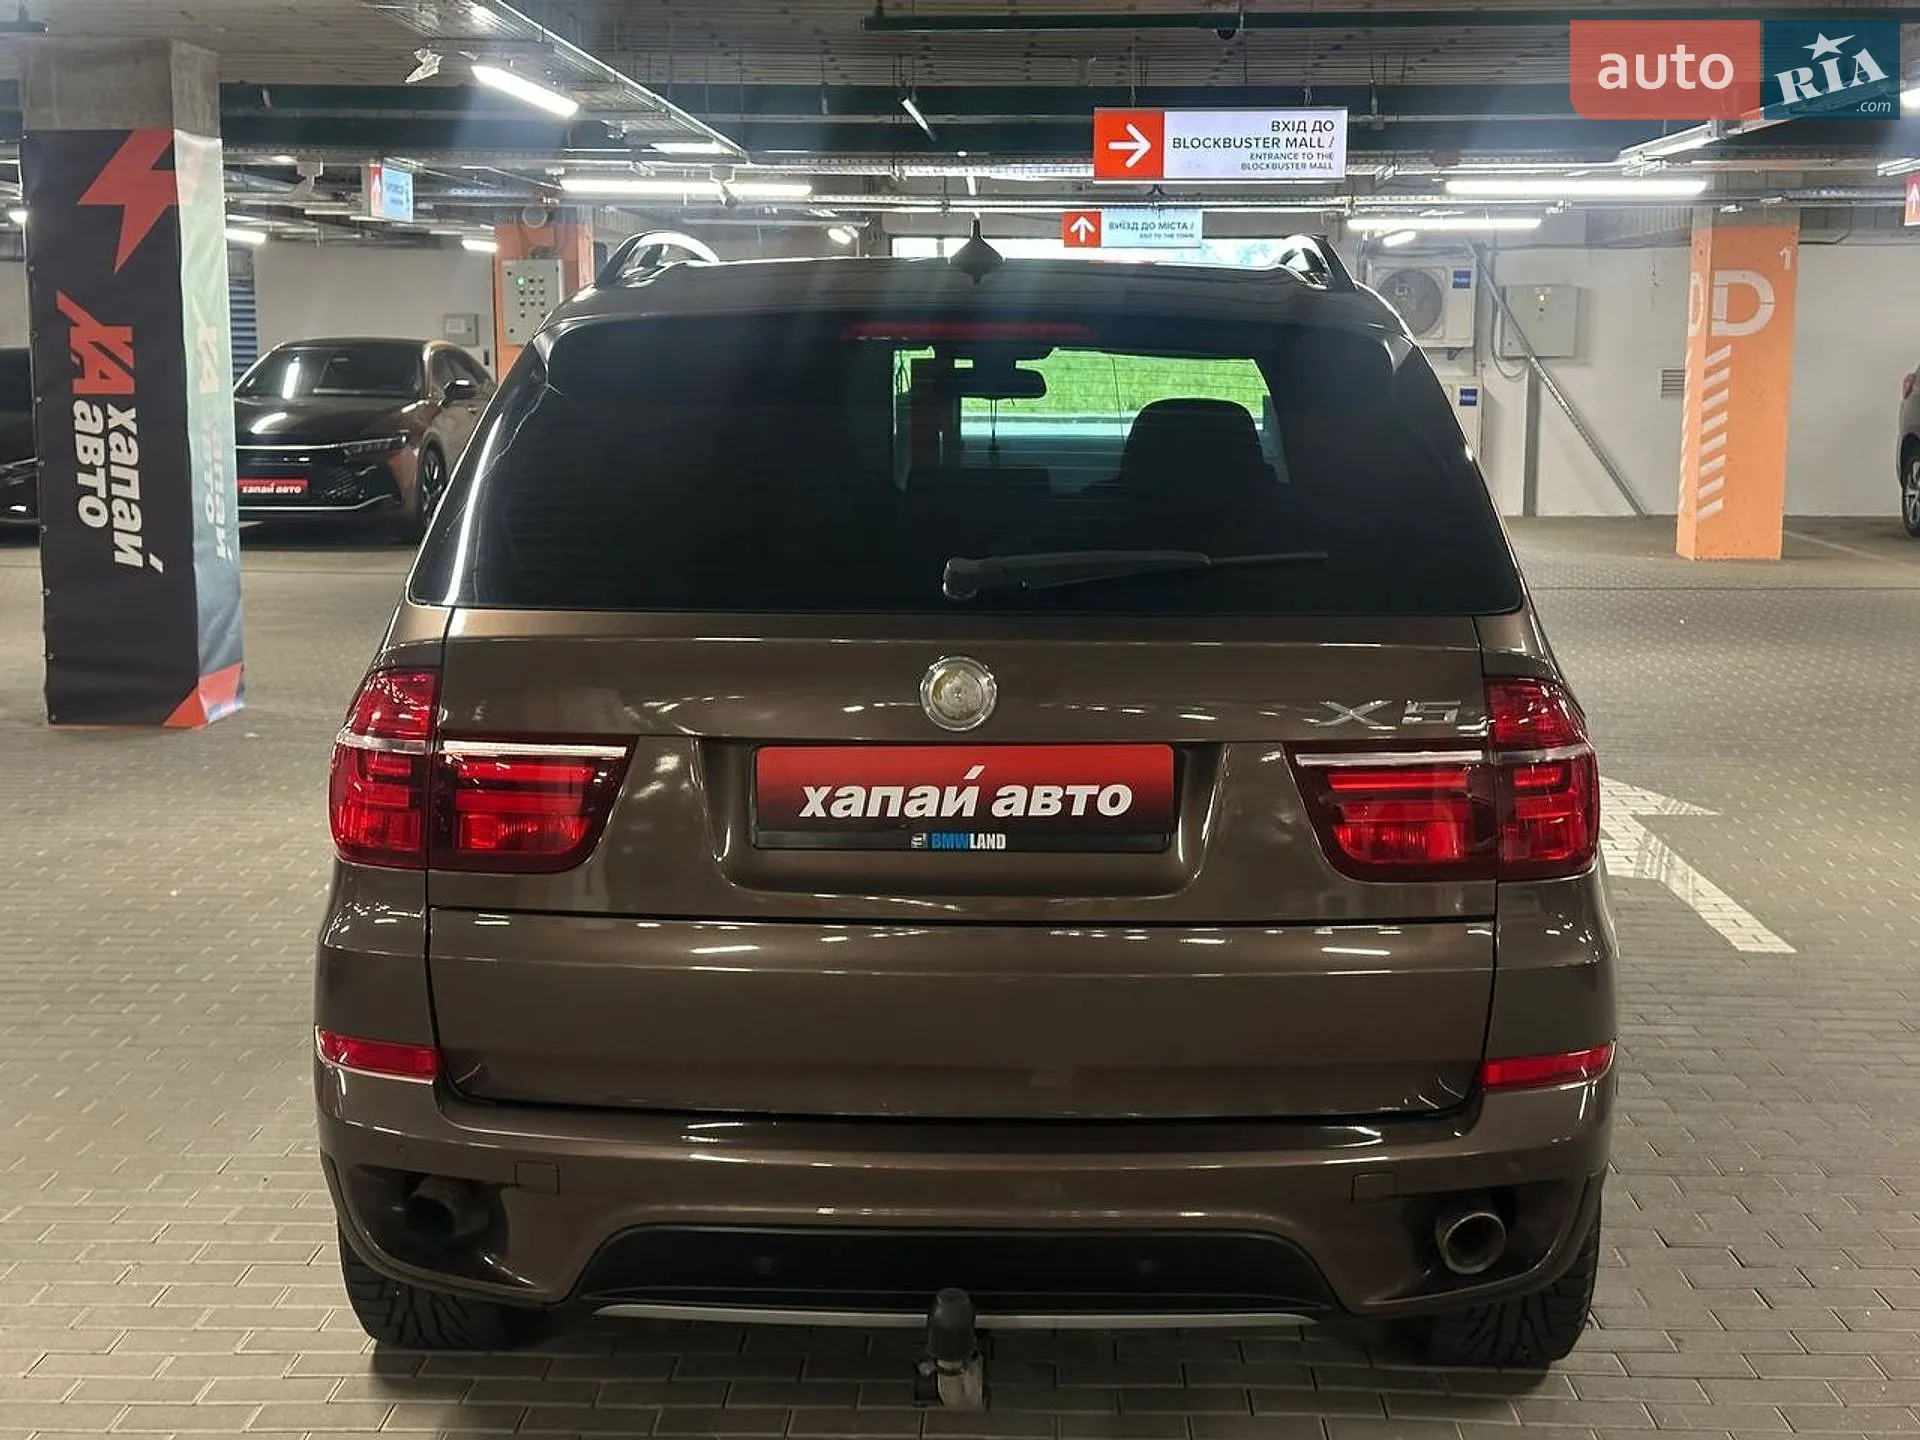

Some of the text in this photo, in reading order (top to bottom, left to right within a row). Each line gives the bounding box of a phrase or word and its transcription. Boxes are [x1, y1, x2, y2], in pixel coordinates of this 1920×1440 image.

[1271, 120, 1334, 134] ВХІД ДО
[1172, 137, 1281, 149] BLOCKBUSTER
[1285, 137, 1324, 149] MALL
[1250, 152, 1334, 160] ENTRANCE TO THE
[1241, 162, 1333, 171] BLOCKBUSTER MALL
[1141, 221, 1156, 231] ДО
[1158, 221, 1188, 230] МІСТА
[1710, 270, 1775, 336] D
[73, 400, 109, 528] авто
[106, 402, 164, 574] хапай
[799, 765, 1132, 818] хапай авто
